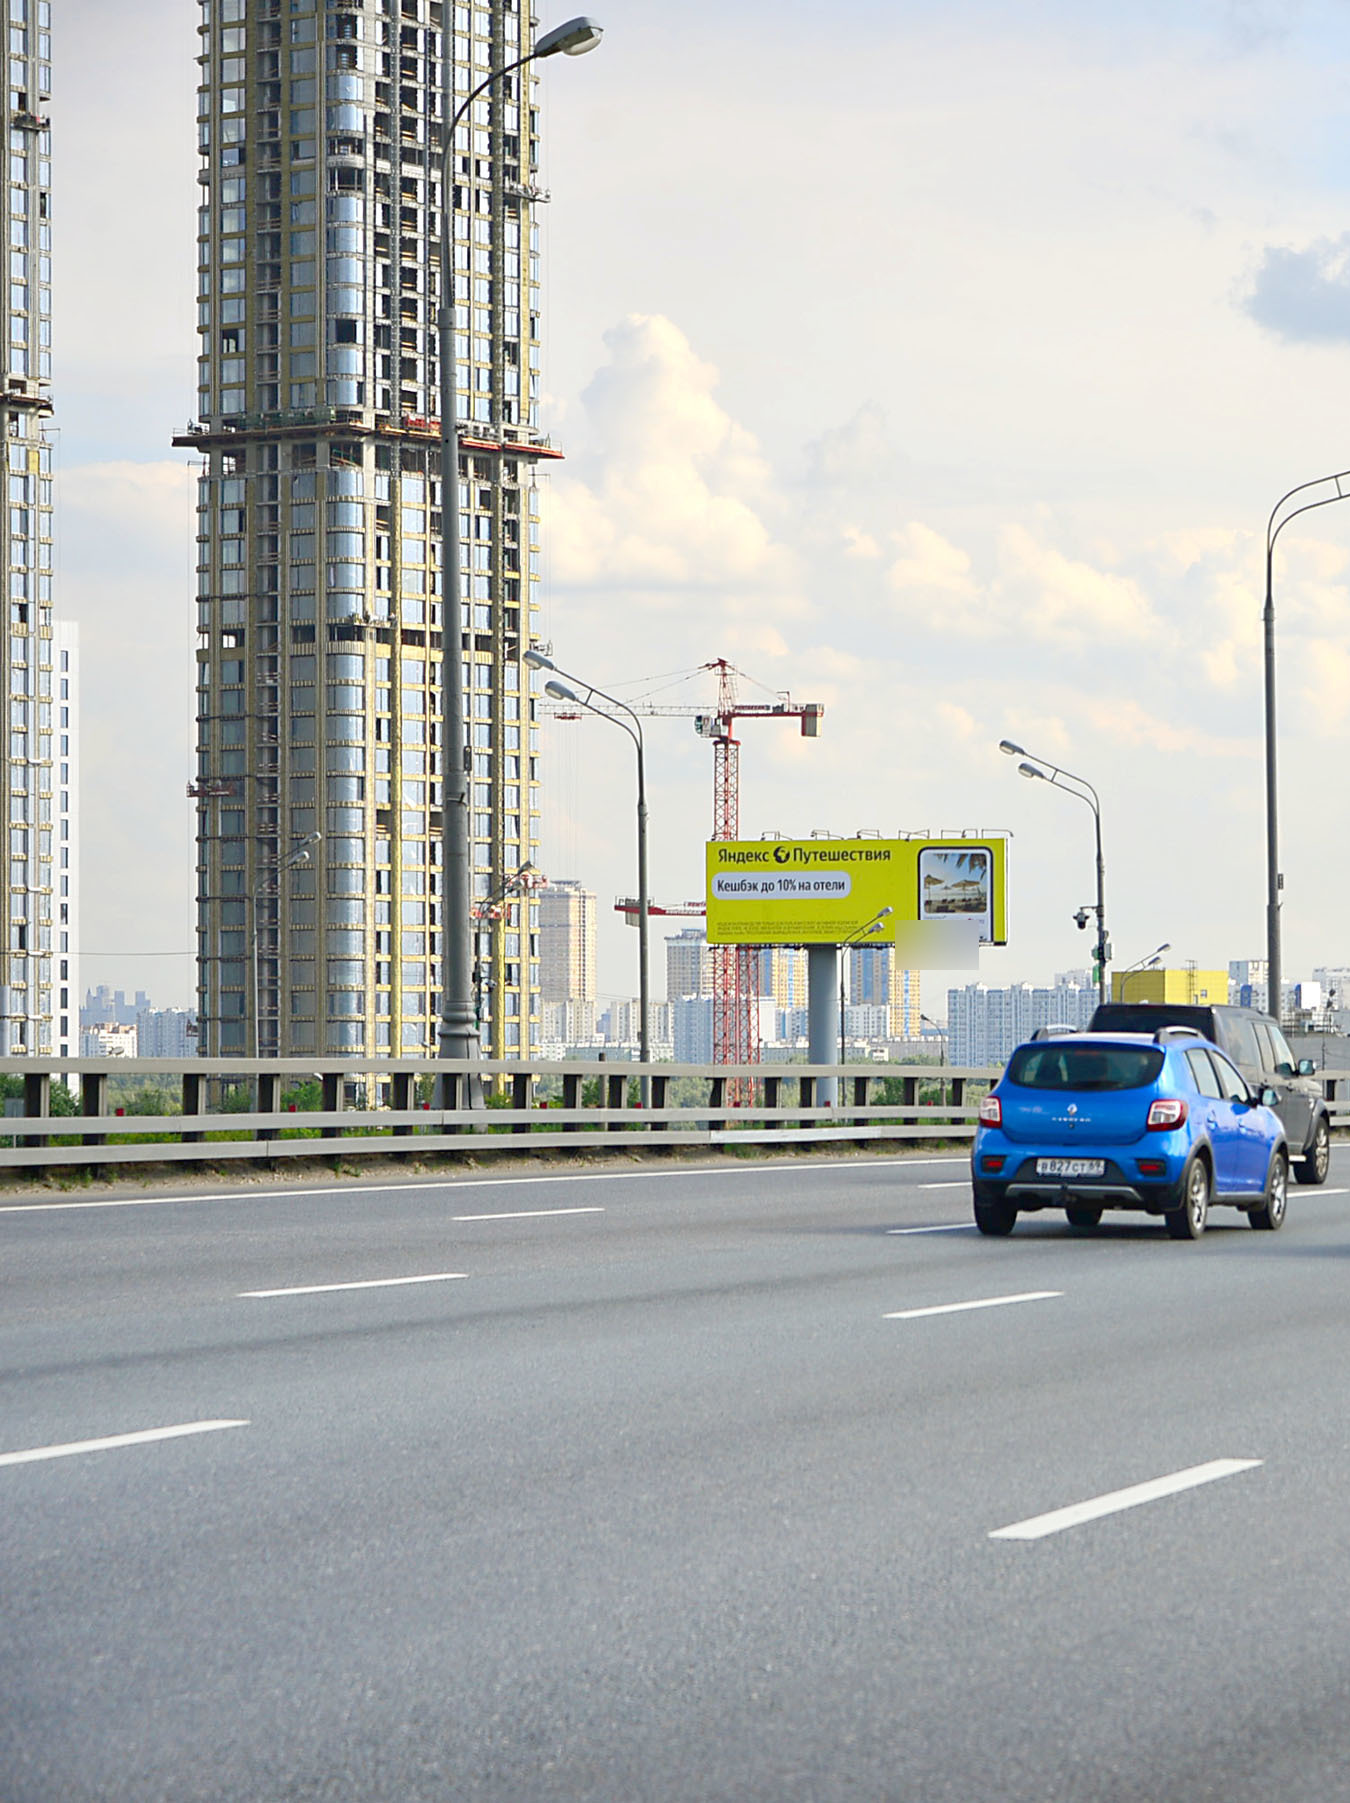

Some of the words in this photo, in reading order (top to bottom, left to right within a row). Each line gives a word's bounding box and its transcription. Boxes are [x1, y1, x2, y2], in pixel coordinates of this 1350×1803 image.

[718, 848, 770, 864] Яндекс
[793, 847, 891, 864] Путешествия
[717, 879, 759, 892] Кешбэк
[761, 881, 775, 893] до
[777, 879, 797, 892] 10%
[798, 881, 811, 891] на
[813, 880, 846, 891] отели
